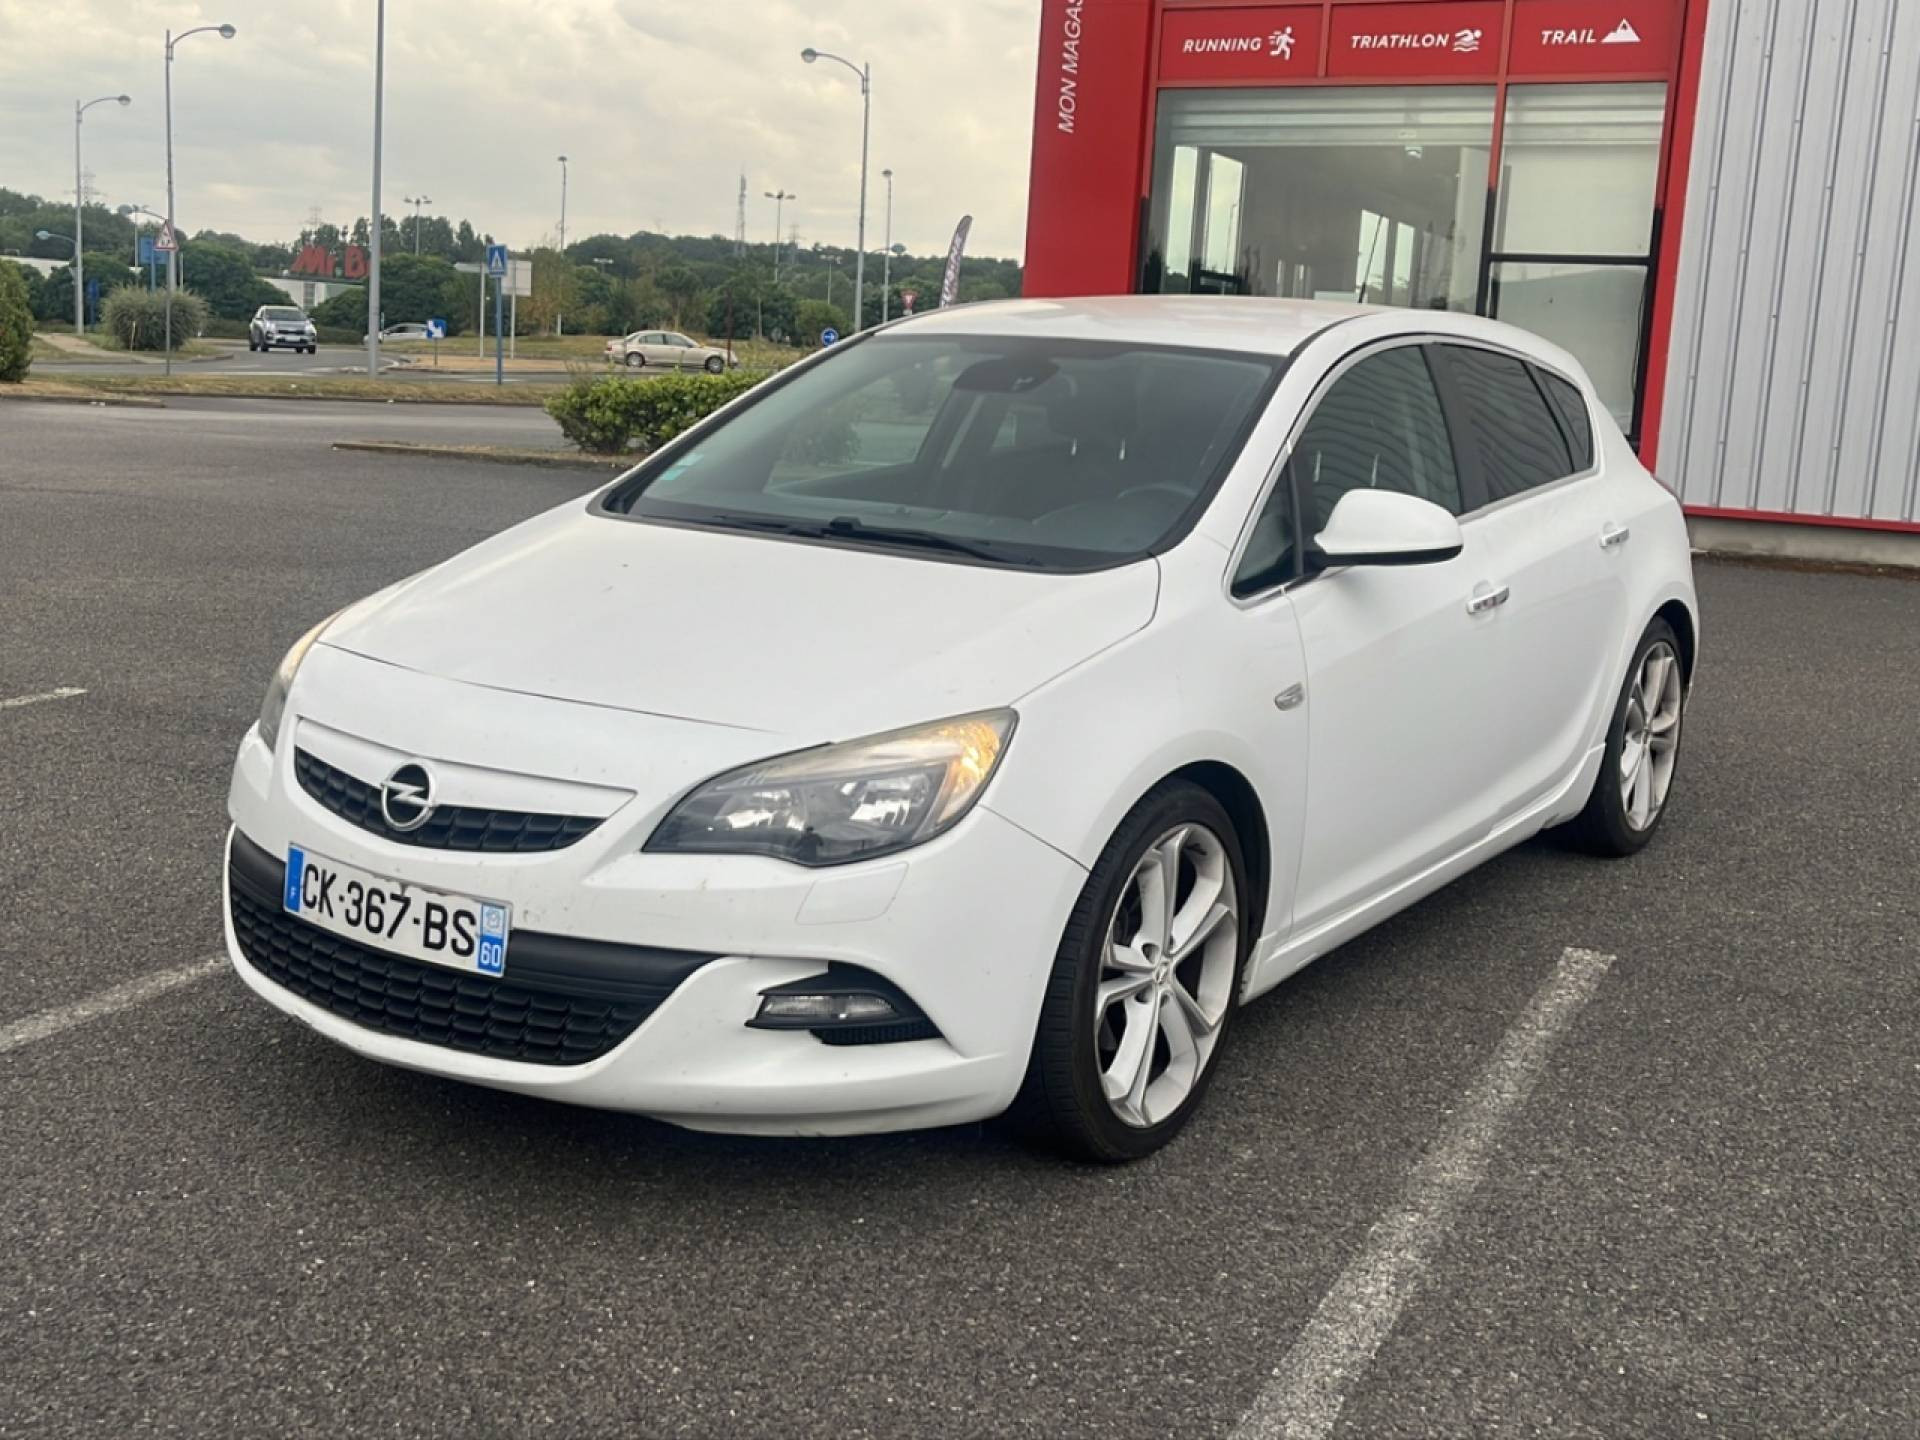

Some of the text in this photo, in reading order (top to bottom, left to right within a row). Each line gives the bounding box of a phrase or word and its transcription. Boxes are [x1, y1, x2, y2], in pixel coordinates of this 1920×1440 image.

[1183, 37, 1262, 53] RUNNING
[1350, 33, 1449, 49] TRIATHLON
[1540, 28, 1597, 46] TRAIL
[1057, 77, 1077, 134] MON
[302, 863, 477, 957] CK-367-BS
[481, 941, 502, 967] 60
